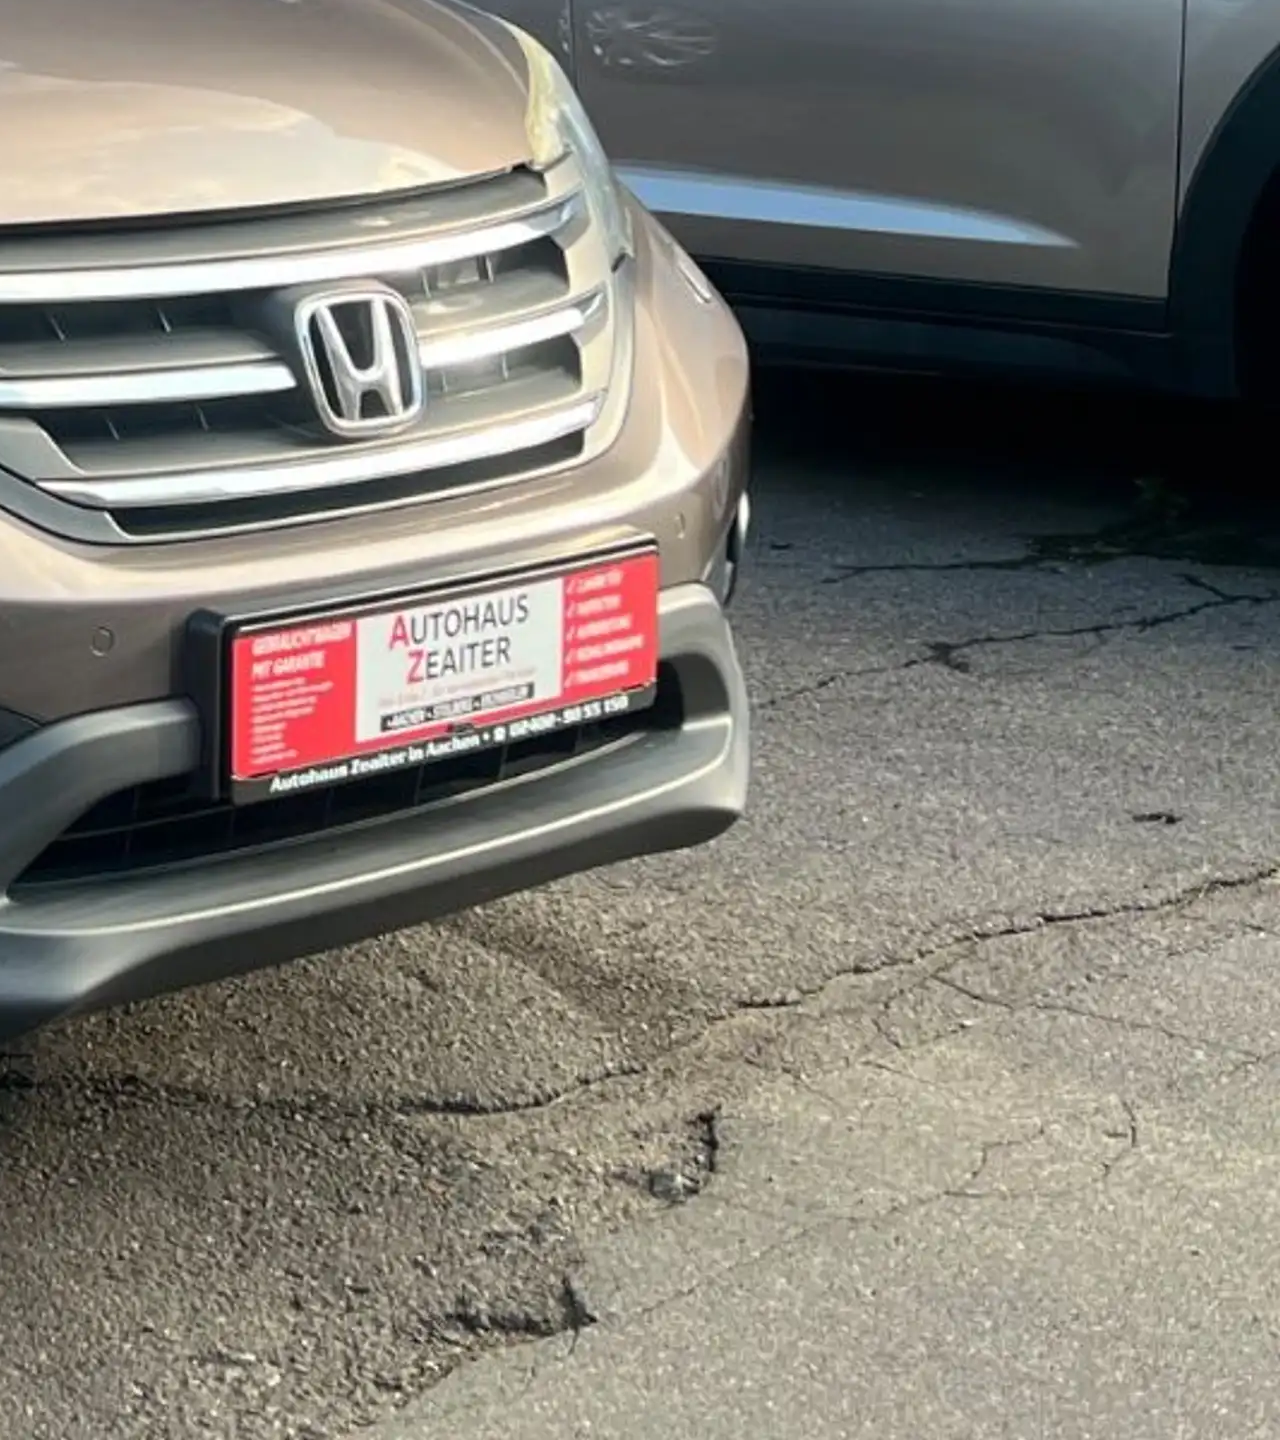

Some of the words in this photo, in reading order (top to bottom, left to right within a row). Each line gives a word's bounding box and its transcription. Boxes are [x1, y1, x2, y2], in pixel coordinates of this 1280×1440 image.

[388, 594, 530, 649] AUTOHAUS
[406, 636, 512, 685] ZEAITER
[270, 764, 348, 793] Autohaus
[351, 749, 407, 775] Zeaiter
[408, 744, 424, 764] in
[425, 733, 481, 759] Aachen
